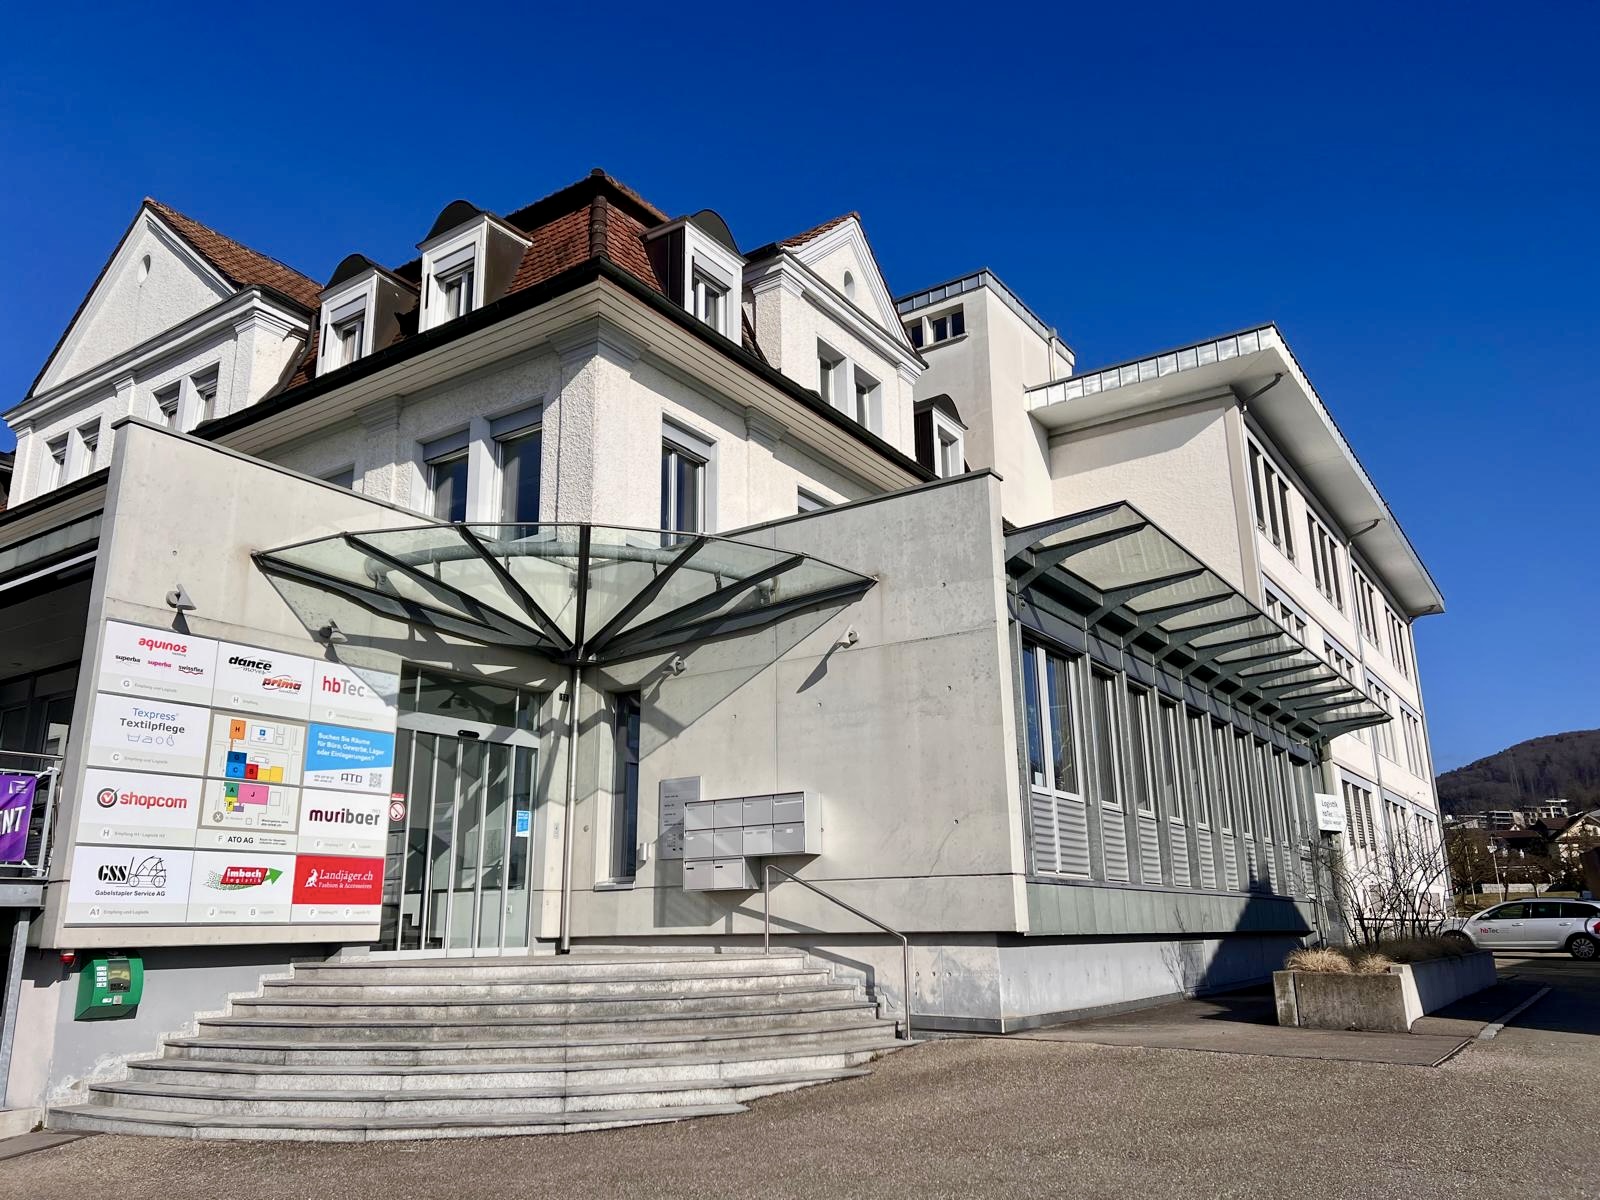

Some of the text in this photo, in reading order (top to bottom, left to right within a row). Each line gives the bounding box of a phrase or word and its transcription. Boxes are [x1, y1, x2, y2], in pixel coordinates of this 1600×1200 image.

[138, 637, 188, 653] aquinos
[228, 656, 272, 671] dance
[262, 678, 302, 690] prima
[322, 675, 365, 697] hbTec
[132, 707, 177, 722] Texpress
[120, 717, 185, 735] Textilpflege
[317, 740, 326, 748] für
[318, 732, 340, 741] Suchen
[351, 736, 370, 745] Räume
[112, 753, 120, 761] C
[316, 748, 330, 757] oder
[340, 773, 363, 784] ATO
[120, 792, 187, 809] shopcom
[0, 806, 26, 835] NT
[308, 808, 380, 826] muribaer
[103, 829, 110, 837] H
[227, 836, 243, 844] ATO
[98, 865, 127, 881] GSS
[226, 868, 262, 878] imbach
[319, 869, 373, 882] Landjäger.ch
[90, 908, 100, 916] A1
